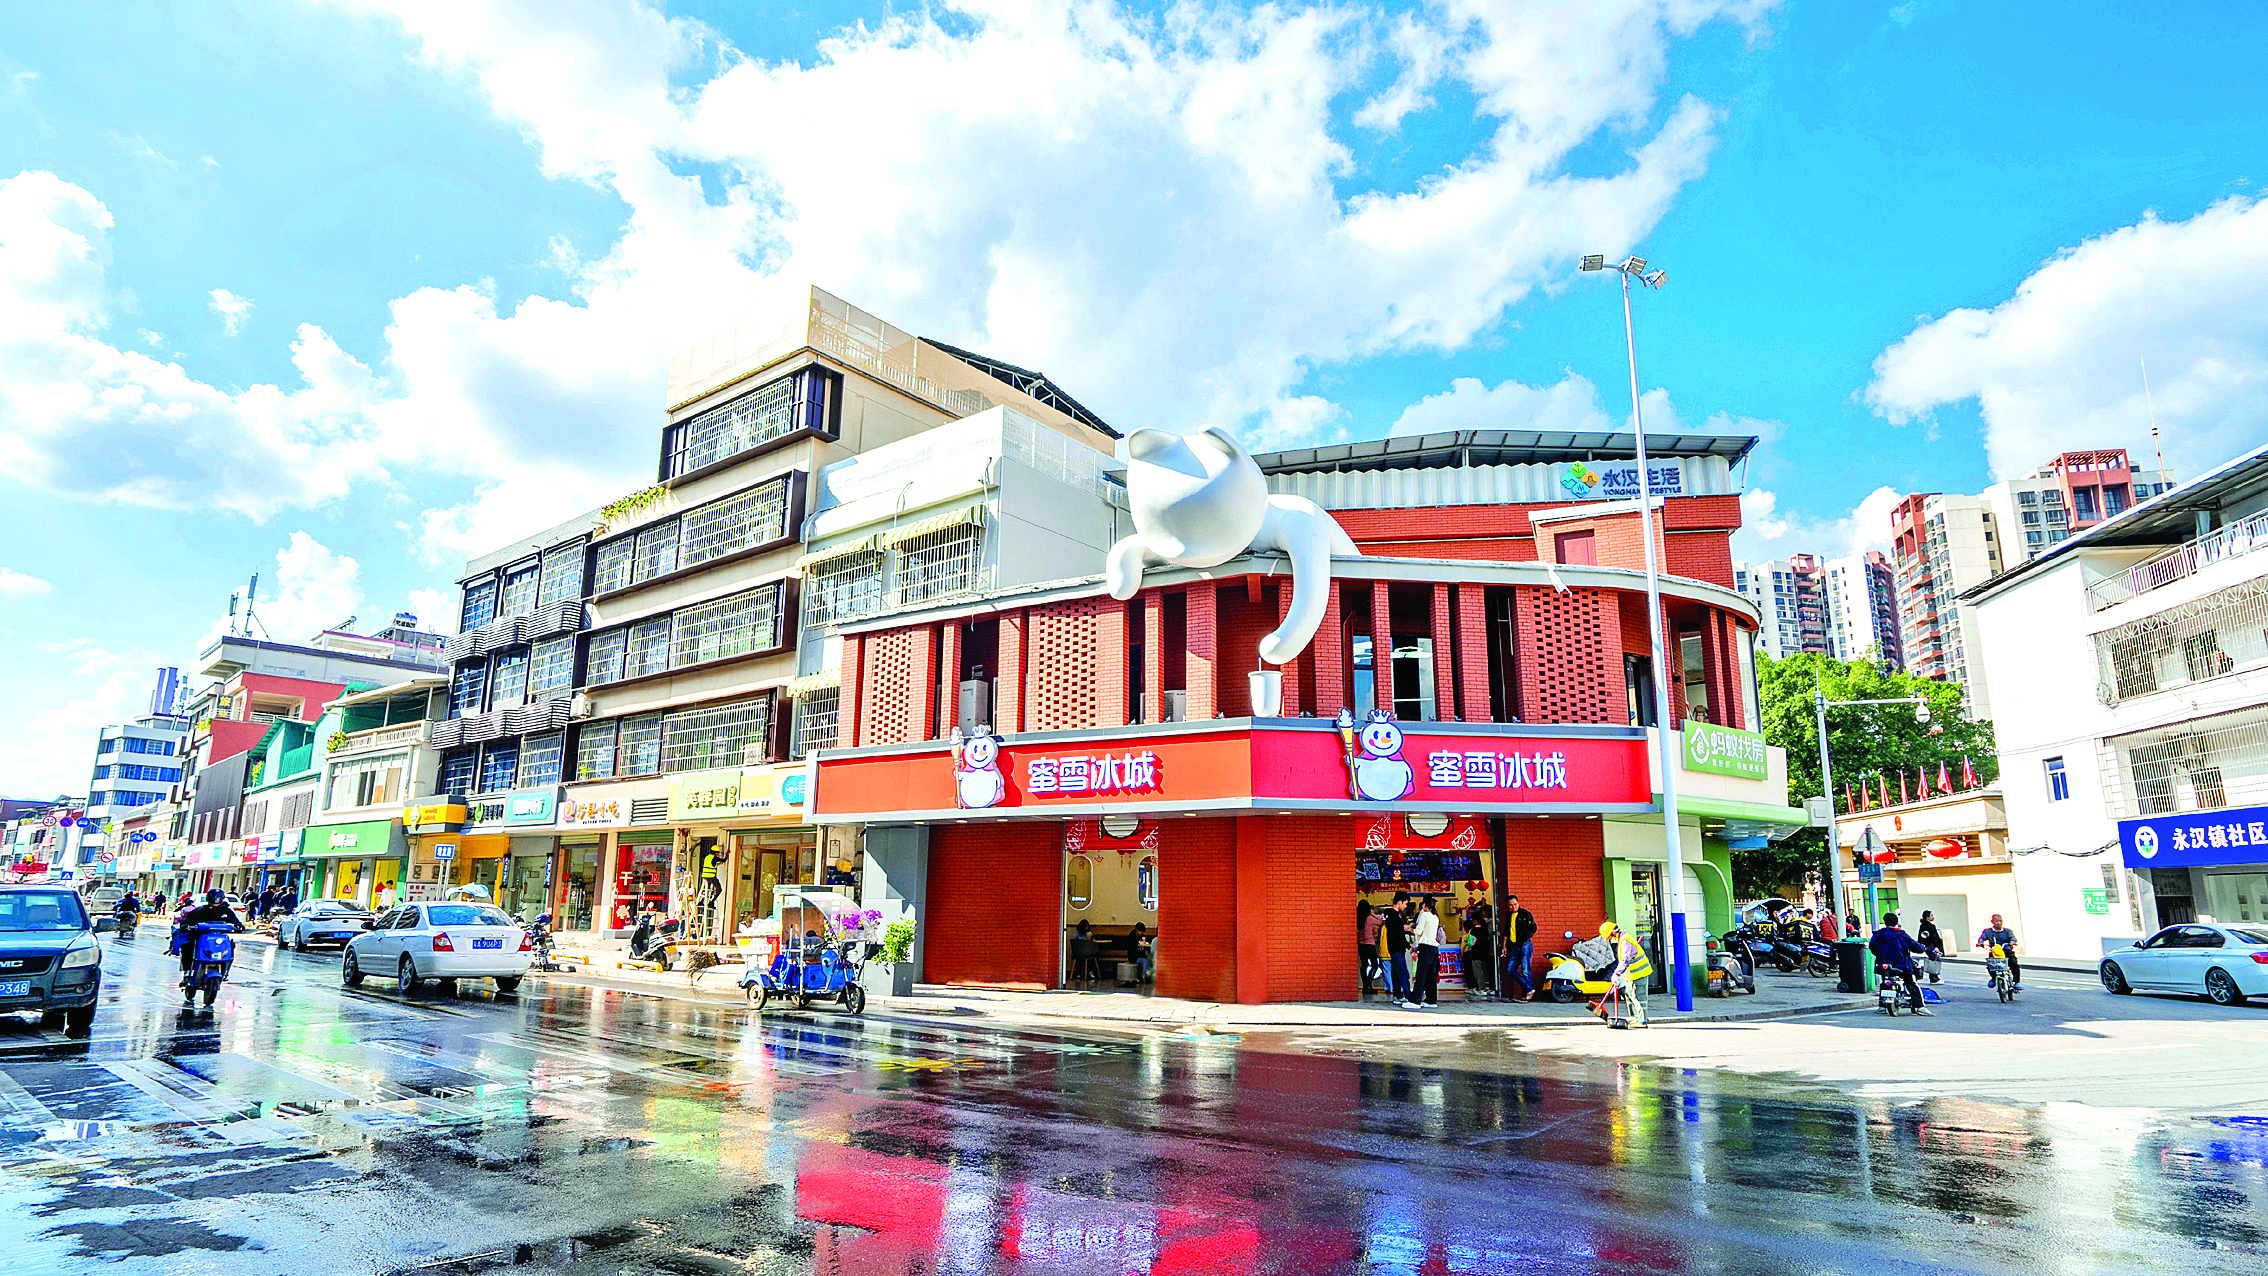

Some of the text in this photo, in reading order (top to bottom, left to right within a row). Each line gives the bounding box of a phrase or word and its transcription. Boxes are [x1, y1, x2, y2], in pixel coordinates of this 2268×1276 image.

[1602, 467, 1680, 487] 永汉生活
[1710, 730, 1764, 762] 蚂蚁找房
[1027, 750, 1155, 793] 蜜雪冰城
[1429, 749, 1567, 788] 蜜雪冰城
[2172, 822, 2268, 850] 永汉镇社区
